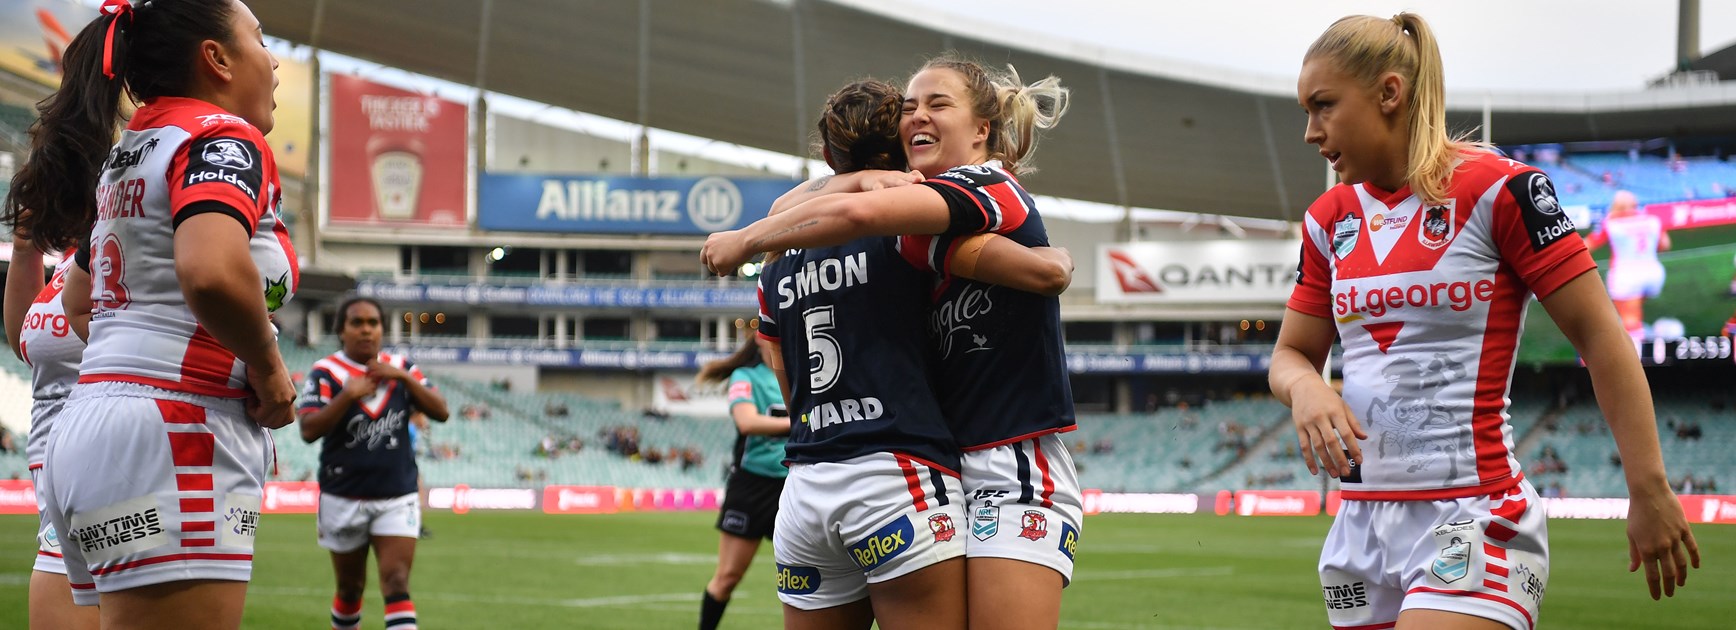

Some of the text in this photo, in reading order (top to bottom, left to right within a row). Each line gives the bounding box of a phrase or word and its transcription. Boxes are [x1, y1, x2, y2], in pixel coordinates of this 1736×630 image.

[189, 169, 255, 199] Holden
[536, 180, 681, 220] Allianz
[1336, 279, 1495, 317] st.george
[803, 305, 842, 394] 5
[345, 408, 405, 451] Steggles
[80, 508, 158, 542] ANYTIME
[1435, 525, 1474, 537] XBLADES
[854, 529, 905, 567] Reflex
